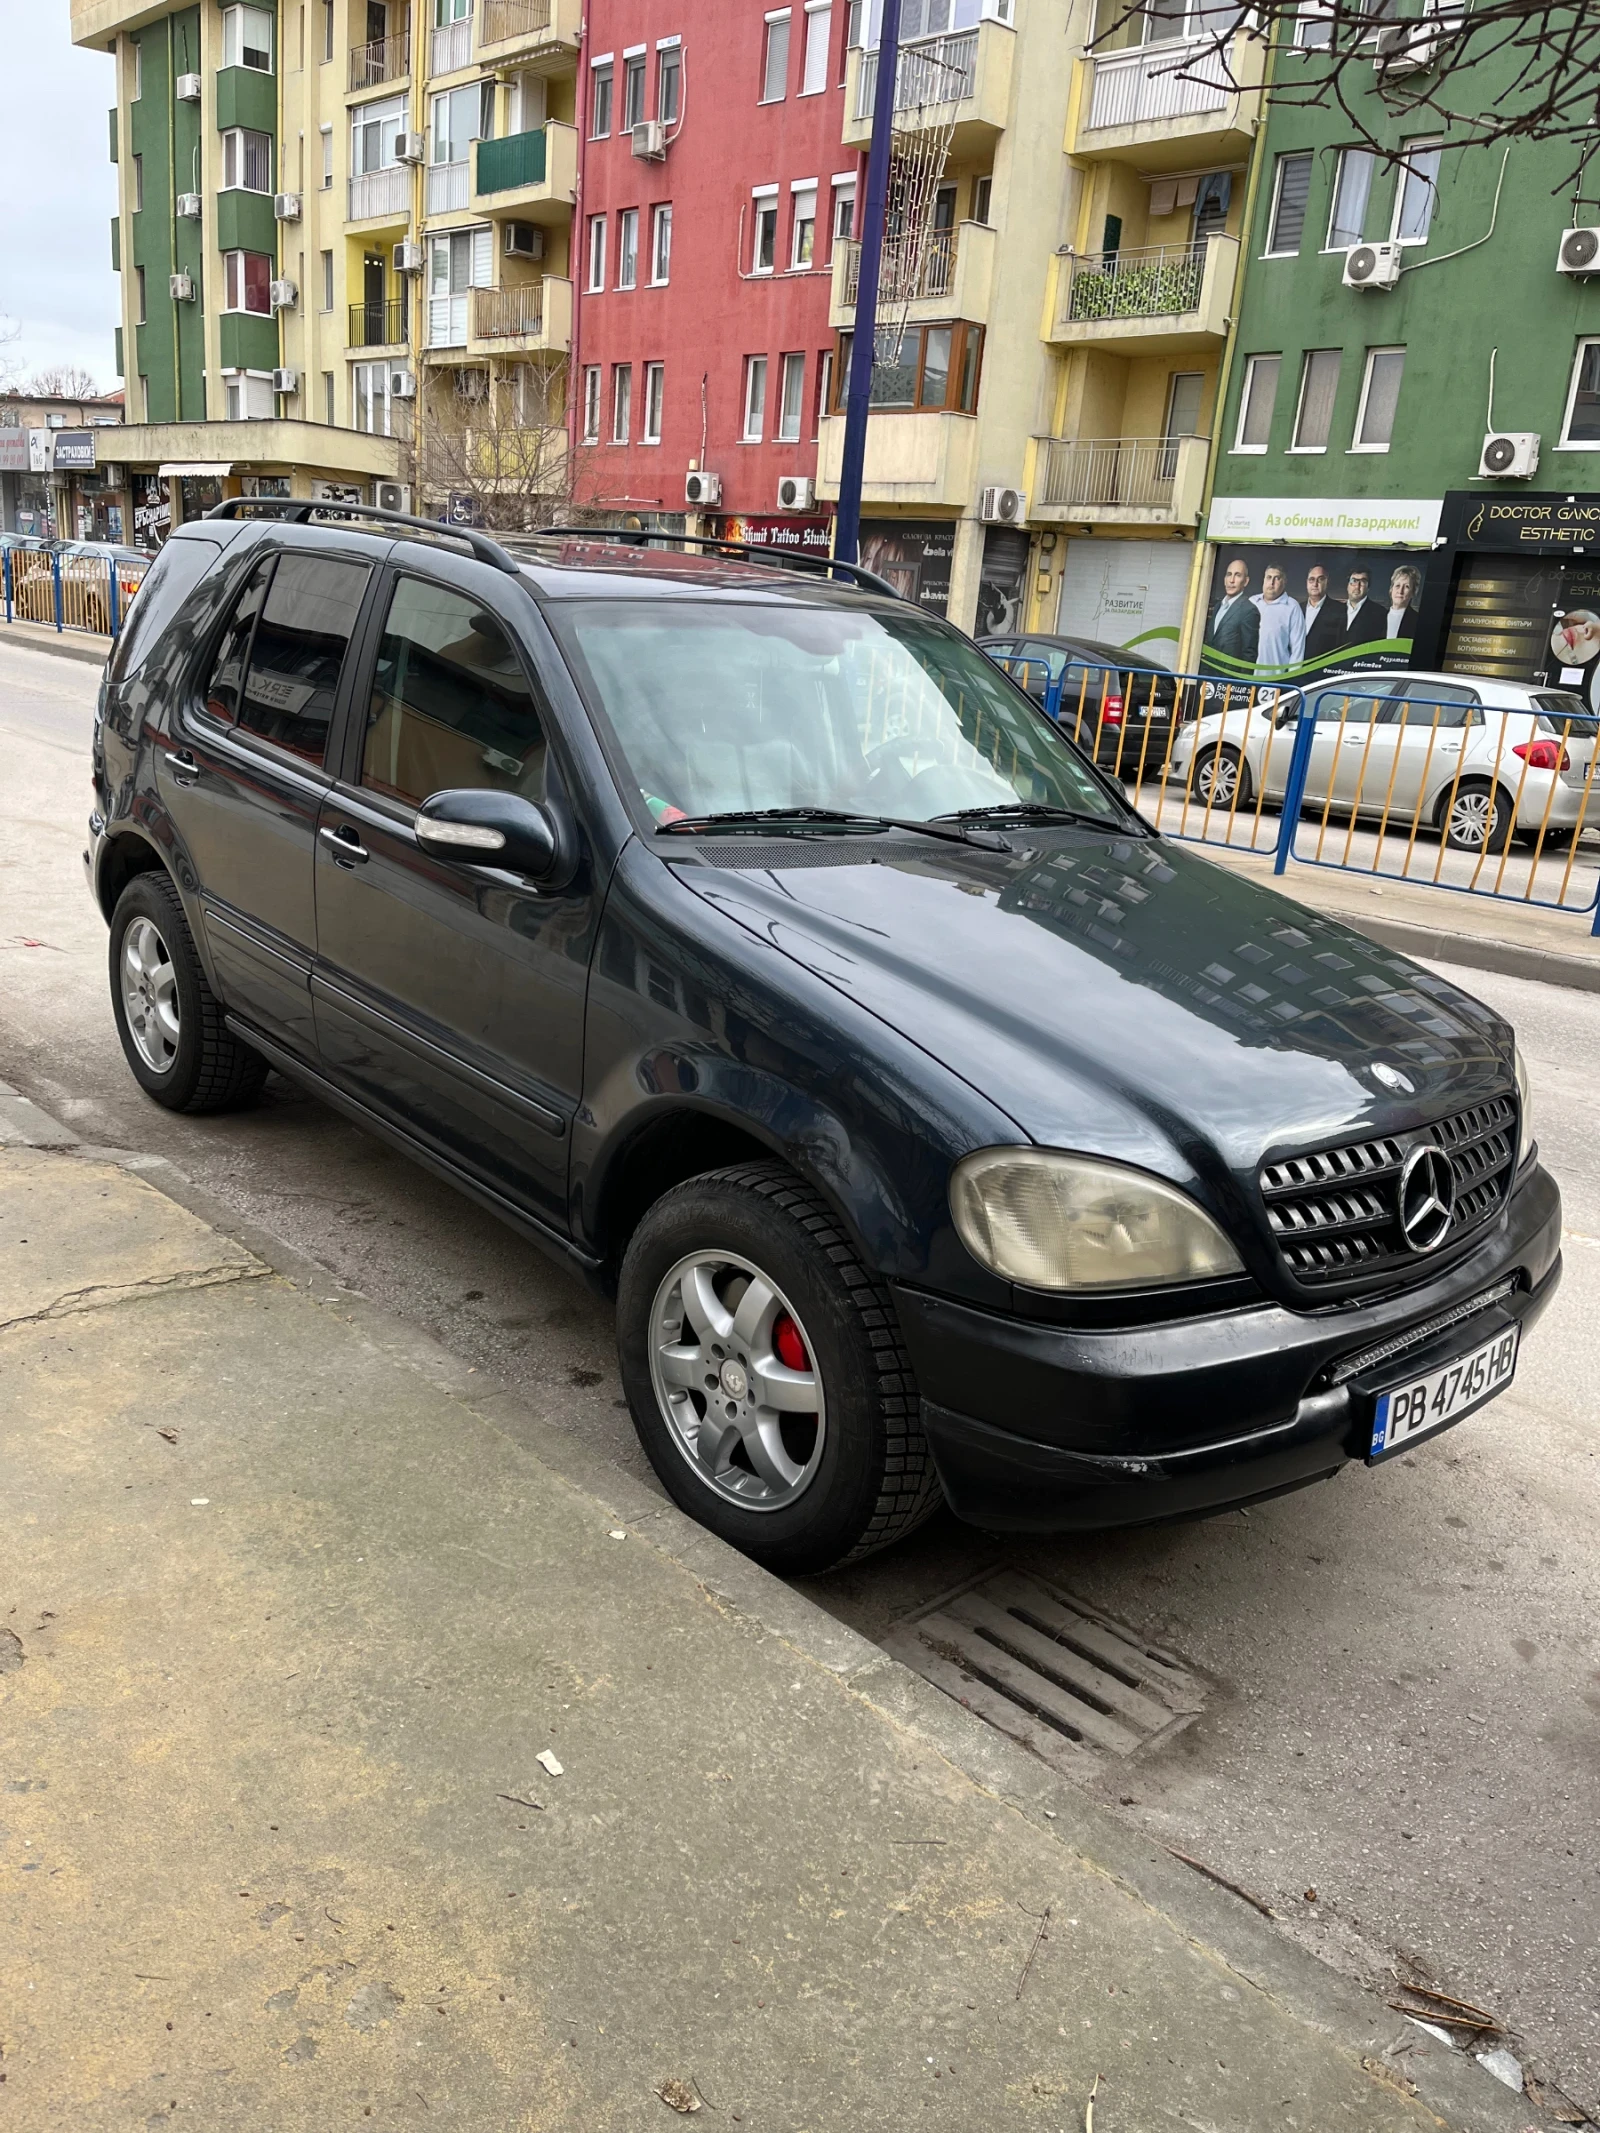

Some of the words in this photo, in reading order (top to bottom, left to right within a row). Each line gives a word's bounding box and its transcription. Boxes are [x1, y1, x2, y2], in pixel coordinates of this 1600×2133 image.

[56, 446, 91, 459] ЗАСТРАХОВКИ
[1490, 506, 1552, 519] DOCTOR
[1557, 507, 1600, 520] GANC
[1265, 513, 1281, 526] Аз
[1284, 513, 1334, 528] обичам
[1337, 514, 1420, 530] Пазарджик!
[770, 526, 800, 544] Tattoo
[1520, 527, 1595, 540] ESTHETIC
[1570, 585, 1600, 596] ESTH
[1105, 600, 1143, 609] РАЗВИТИЕ
[1352, 661, 1382, 669] Действия
[1379, 656, 1410, 664] Резултат
[1216, 682, 1247, 694] Бъеще
[1260, 689, 1277, 702] 21
[1390, 1385, 1427, 1440] PB
[1431, 1352, 1488, 1417] 4745
[1486, 1334, 1514, 1387] HB
[1371, 1431, 1385, 1446] BG
